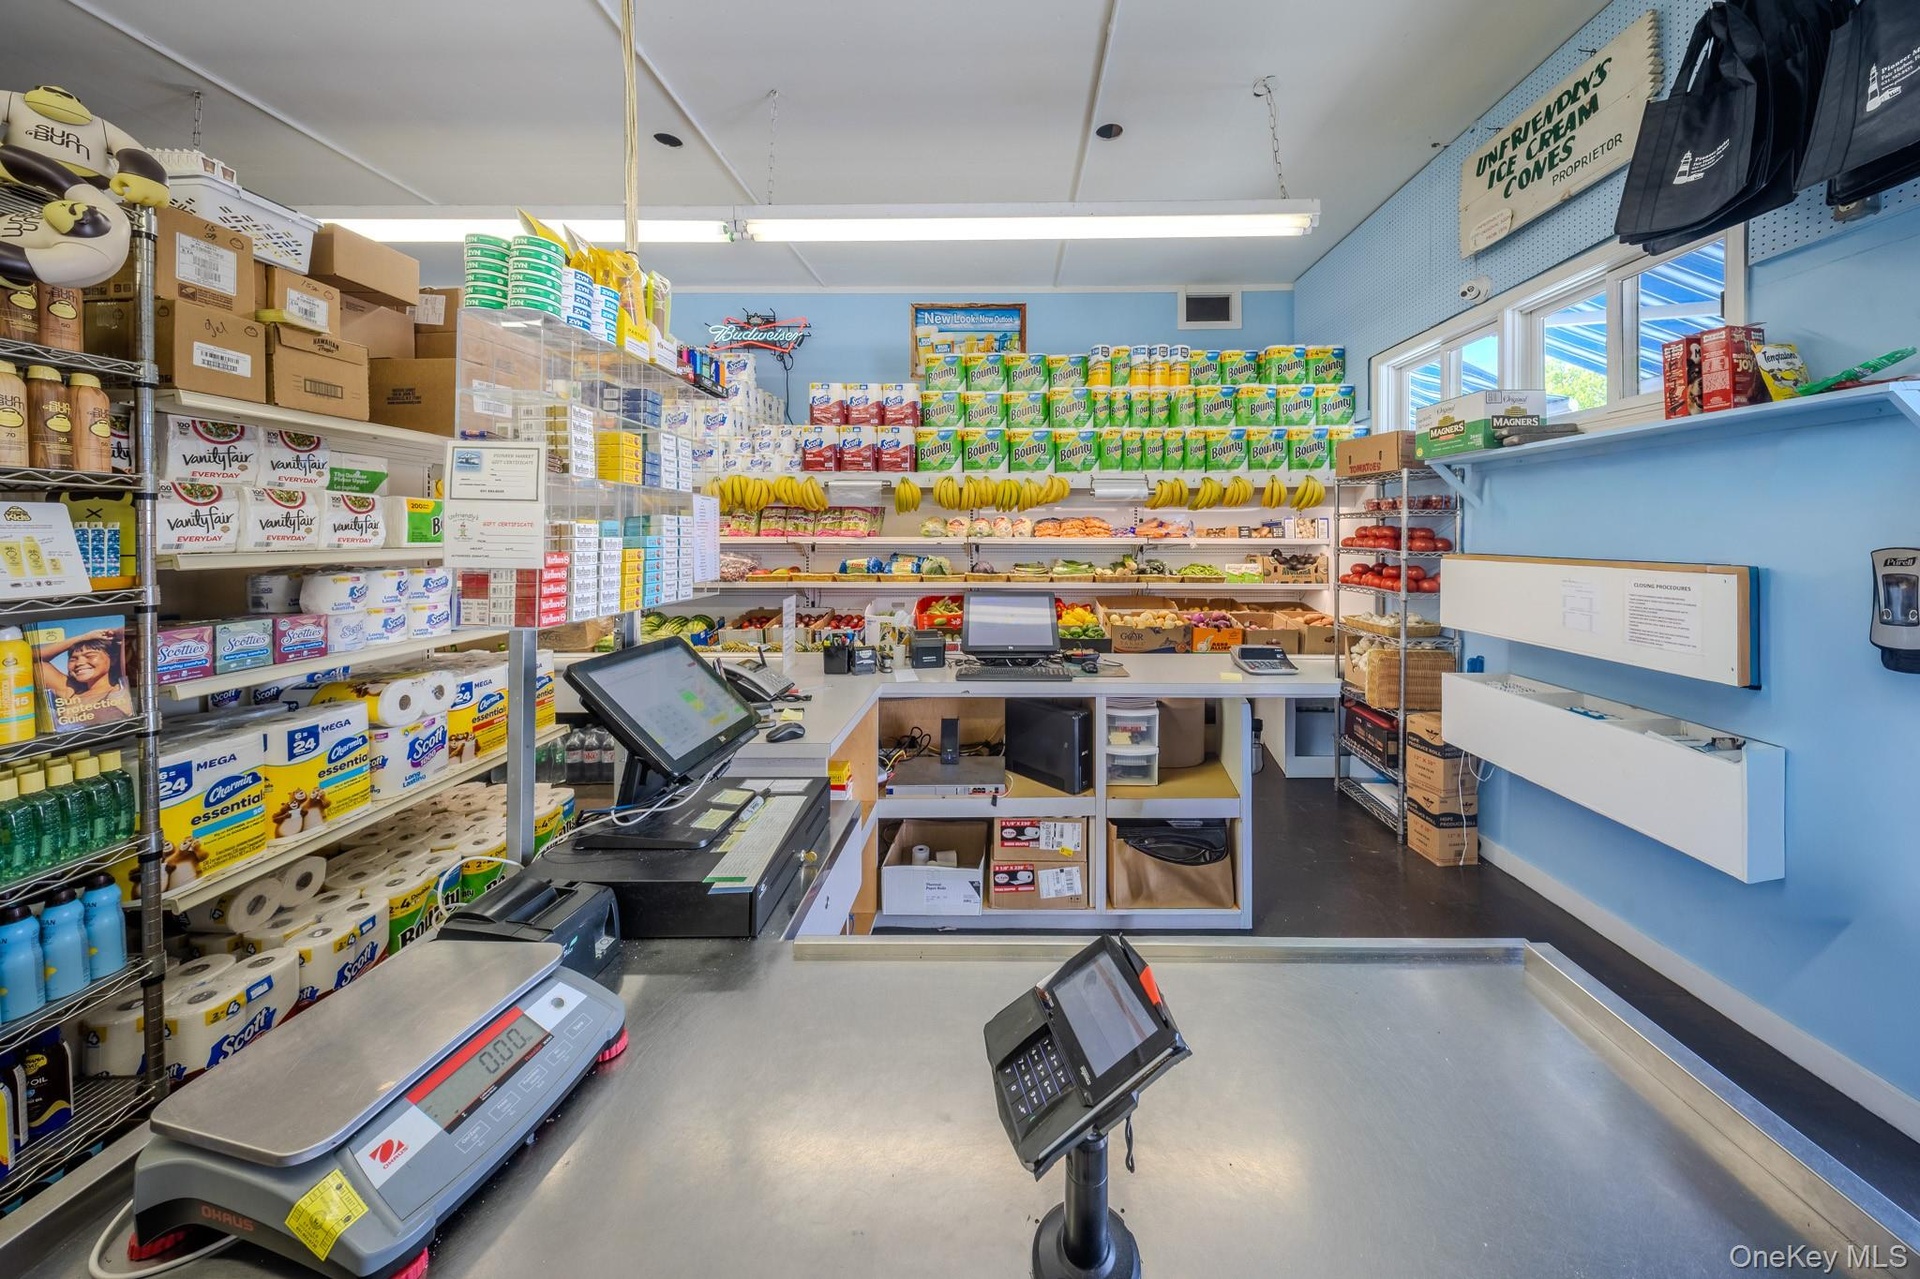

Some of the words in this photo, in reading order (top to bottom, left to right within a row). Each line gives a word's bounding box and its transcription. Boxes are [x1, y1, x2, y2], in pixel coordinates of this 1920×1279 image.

[1881, 54, 1911, 74] Pioneer
[1475, 57, 1612, 177] UNFRIENDLY'S
[1487, 155, 1516, 189] ICE
[1525, 94, 1599, 160] CREAM
[1504, 135, 1575, 199] CONES
[1552, 133, 1622, 186] PROPRIETOR
[513, 262, 528, 270] ZYN
[575, 272, 590, 283] ZYN
[575, 284, 591, 294] ZYN
[601, 287, 616, 298] ZYN
[574, 295, 589, 306] ZYN
[573, 306, 588, 317] ZYN
[924, 312, 951, 325] New
[978, 314, 994, 324] New
[205, 318, 228, 338] gel
[568, 318, 584, 328] ZYN
[709, 325, 803, 342] Budweiser
[312, 337, 340, 352] HAWAIIAN
[970, 364, 1000, 382] Bounty
[1012, 365, 1042, 382] Bounty
[1052, 366, 1082, 384] Bounty
[1190, 362, 1217, 378] Bounty
[1228, 363, 1257, 379] Bounty
[1277, 359, 1305, 375] Bounty
[1314, 358, 1343, 377] Bounty
[812, 394, 831, 406] Scott
[849, 394, 869, 406] Scott
[885, 394, 903, 406] Scott
[1203, 398, 1233, 416] Bounty
[1282, 398, 1312, 416] Bounty
[1320, 398, 1352, 416] Bounty
[925, 403, 956, 422] Bounty
[968, 404, 999, 422] Bounty
[1010, 403, 1041, 422] Bounty
[1054, 400, 1086, 419] Bounty
[176, 420, 190, 429] 100
[1492, 417, 1539, 427] MAGNERS
[6, 431, 16, 439] 70
[266, 431, 279, 439] 100
[1430, 423, 1464, 438] MAGNERS
[804, 438, 824, 449] Scott
[843, 438, 861, 449] Scott
[880, 438, 899, 449] Scott
[920, 440, 952, 461] Bounty
[967, 440, 1000, 460] Bounty
[1211, 440, 1244, 460] Bounty
[1252, 439, 1284, 459] Bounty
[1294, 439, 1326, 459] Bounty
[1014, 442, 1047, 462] Bounty
[1060, 442, 1093, 462] Bounty
[191, 470, 240, 479] EVERYDAY
[1349, 462, 1381, 474] TOMATOES
[278, 475, 318, 484] EVERYDAY
[331, 495, 342, 503] 100
[177, 535, 223, 543] EVERYDAY
[266, 534, 307, 542] EVERYDAY
[1886, 557, 1914, 566] Purell
[424, 577, 449, 590] Scott
[1655, 583, 1691, 592] PROCEDURES
[384, 615, 406, 629] Scott
[428, 610, 450, 623] Scott
[222, 634, 267, 652] Scotties
[282, 626, 322, 645] Scotties
[158, 642, 206, 663] Scotties
[474, 678, 493, 689] MEGA
[211, 688, 238, 701] Scott
[253, 687, 279, 701] Scott
[55, 698, 81, 707] Sun
[58, 712, 95, 726] Guide
[293, 739, 317, 755] 24
[320, 719, 352, 733] MEGA
[414, 725, 446, 757] Scott
[331, 736, 364, 760] Charmin
[1408, 740, 1428, 753] PRODUCE
[1428, 748, 1442, 757] ROLL
[159, 780, 188, 797] 24
[196, 752, 237, 772] MEGA
[402, 773, 427, 788] Lasting
[404, 770, 421, 782] Long
[209, 773, 253, 804] Charmin
[344, 941, 377, 982] Scott
[221, 1005, 267, 1058] Scott
[30, 1078, 49, 1087] OIL
[383, 1145, 409, 1170] OHAUS
[200, 1206, 255, 1232] OHAUS
